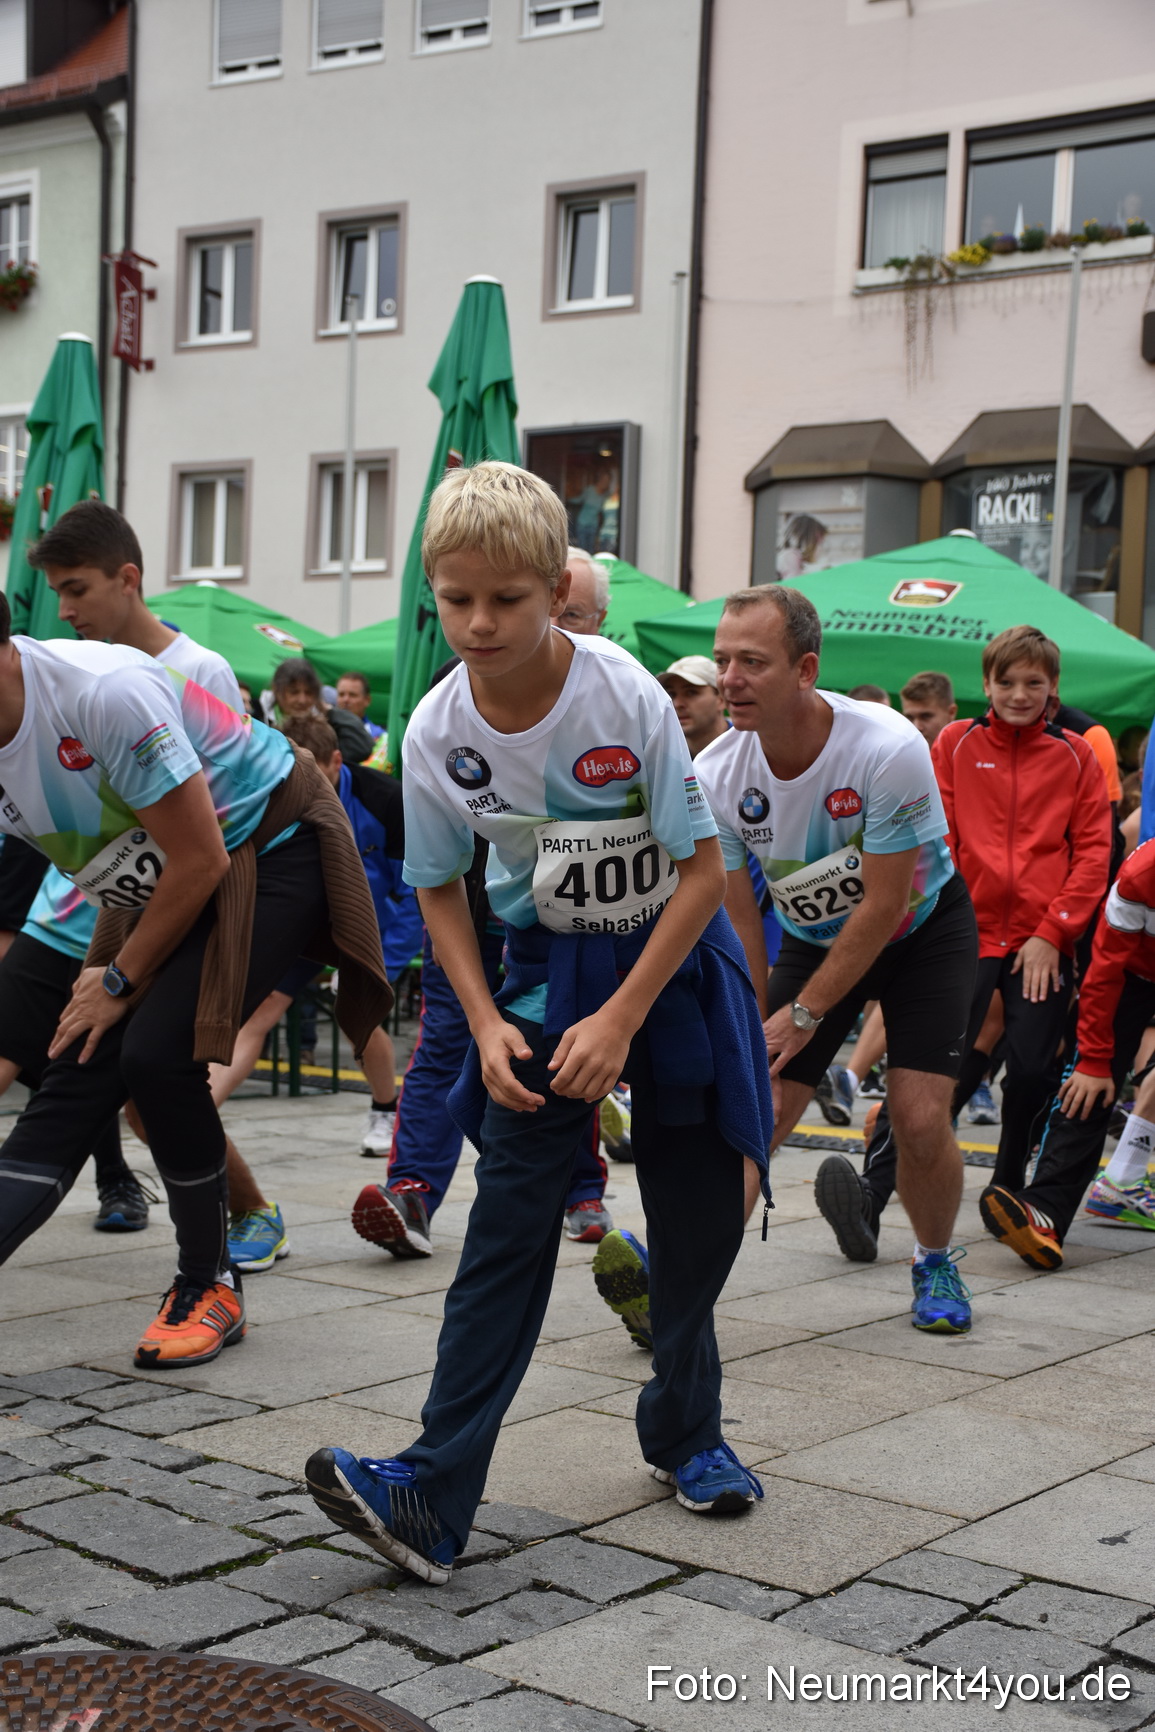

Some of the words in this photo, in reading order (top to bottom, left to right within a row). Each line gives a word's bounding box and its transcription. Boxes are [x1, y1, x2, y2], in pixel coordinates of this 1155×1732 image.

[978, 492, 1039, 525] RACKL
[830, 609, 990, 626] Neumarkter
[447, 748, 482, 762] BMW
[582, 757, 634, 778] Hervis
[465, 792, 505, 811] PART
[541, 838, 598, 854] PARTL
[602, 829, 652, 850] Neum
[81, 845, 134, 890] Neumarkt
[785, 865, 843, 894] Neumarkt
[571, 894, 673, 934] Sebastia
